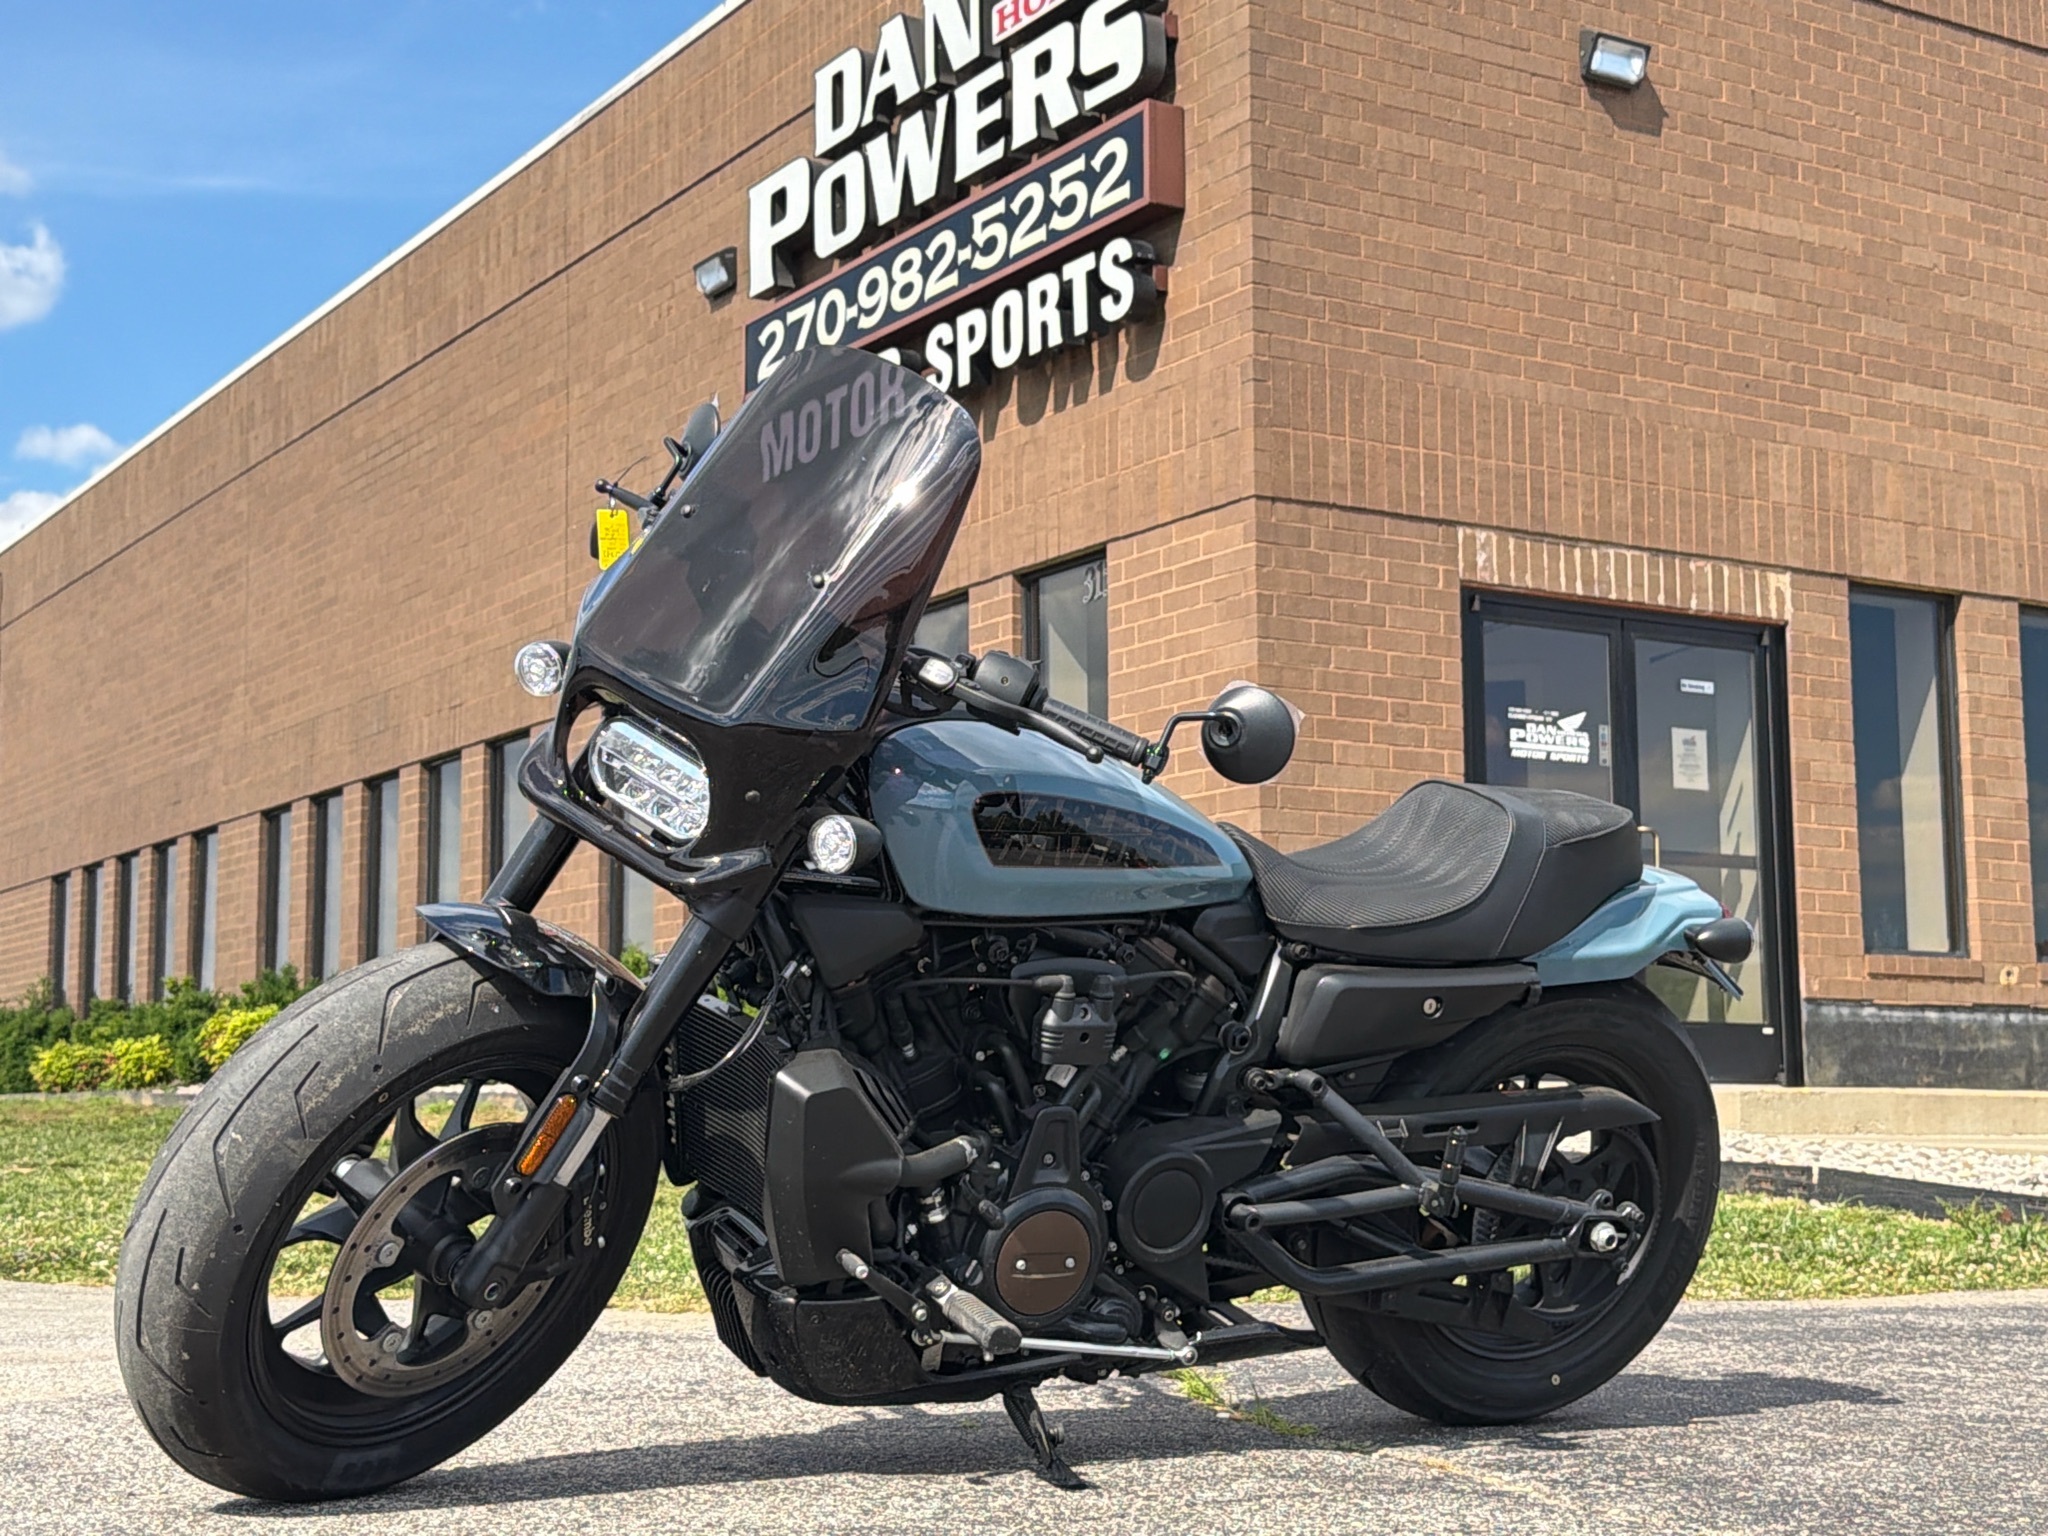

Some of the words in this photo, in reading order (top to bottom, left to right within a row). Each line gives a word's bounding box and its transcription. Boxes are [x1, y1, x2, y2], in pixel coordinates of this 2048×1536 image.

[748, 0, 1145, 298] POWERS
[814, 0, 981, 157] DAN
[757, 136, 1132, 385] 270-982-5252
[760, 348, 907, 483] MOTOR
[925, 237, 1135, 394] SPORTS
[1082, 560, 1107, 604] 31
[1509, 727, 1590, 748] POWERS
